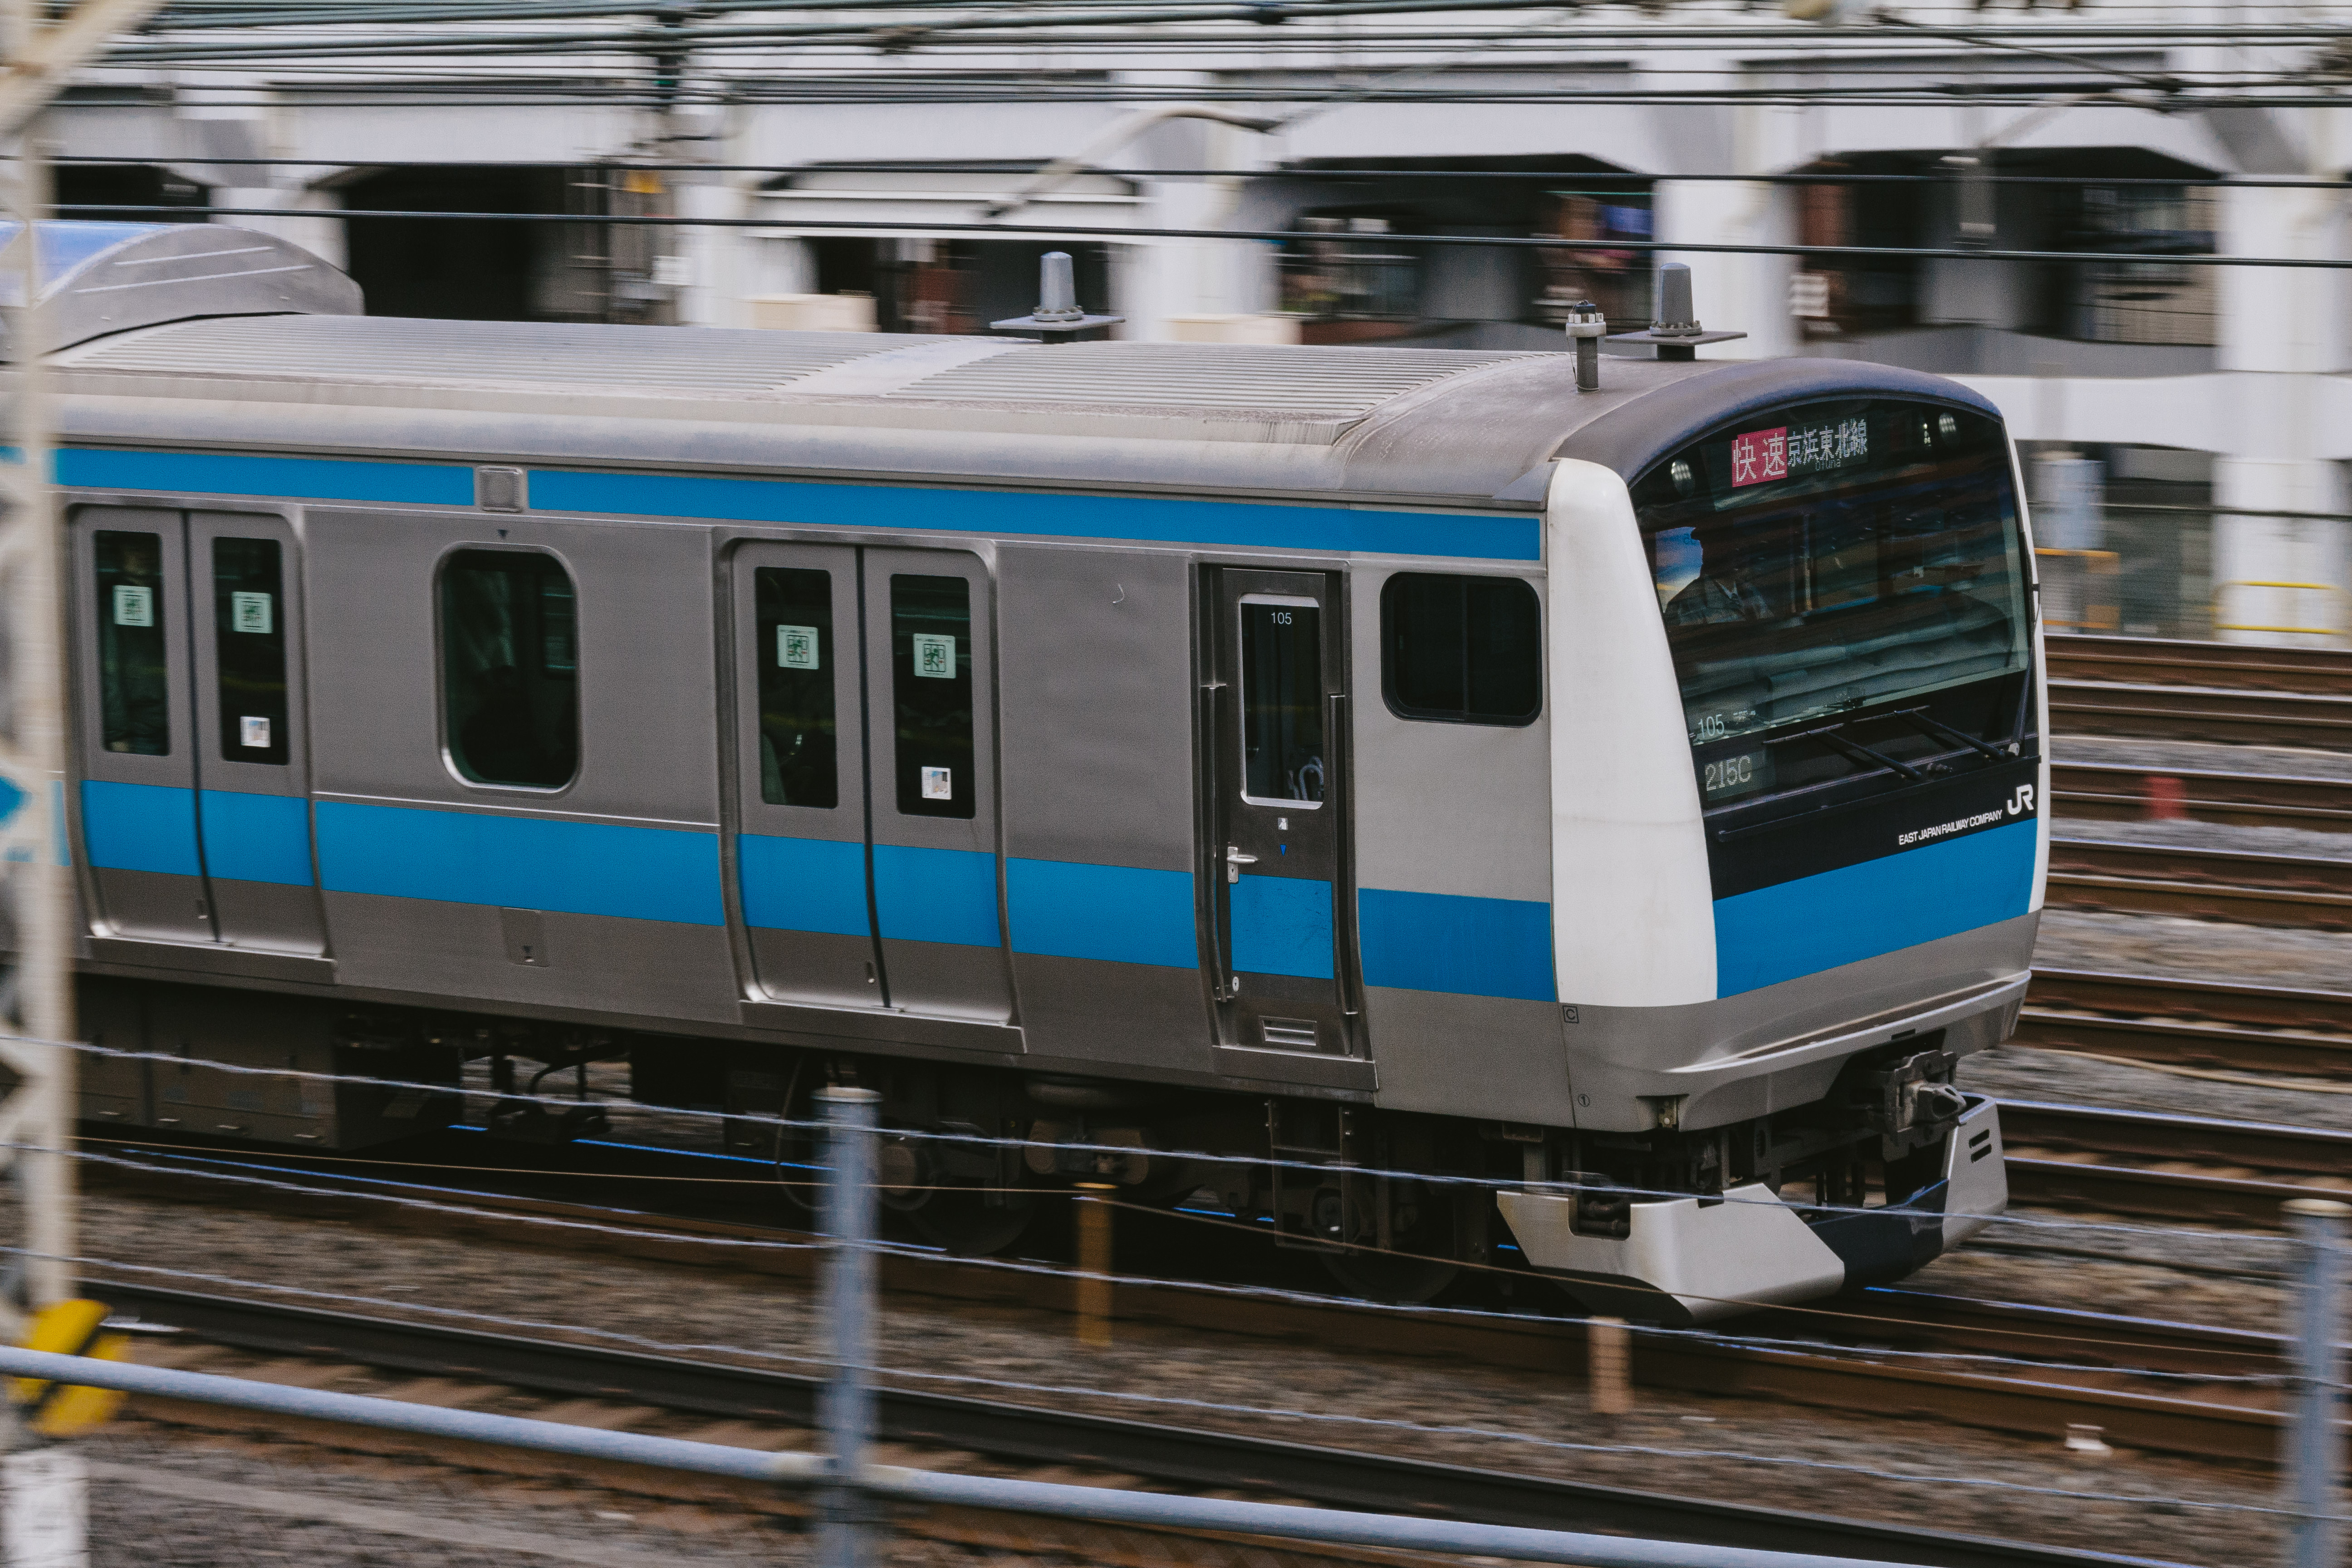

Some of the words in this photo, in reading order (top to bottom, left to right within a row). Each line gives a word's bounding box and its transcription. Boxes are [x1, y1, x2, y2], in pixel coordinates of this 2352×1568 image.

[1733, 433, 1785, 482] 快速
[1271, 612, 1292, 625] 105
[1698, 714, 1725, 738] 105
[1705, 755, 1751, 791] 215C
[2007, 784, 2034, 815] JR
[1899, 831, 1918, 845] EAST
[1918, 825, 1941, 840] JAPAN
[1942, 818, 1969, 834] RAILWAY
[1970, 809, 2003, 827] COMPANY
[1565, 1008, 1577, 1021] C
